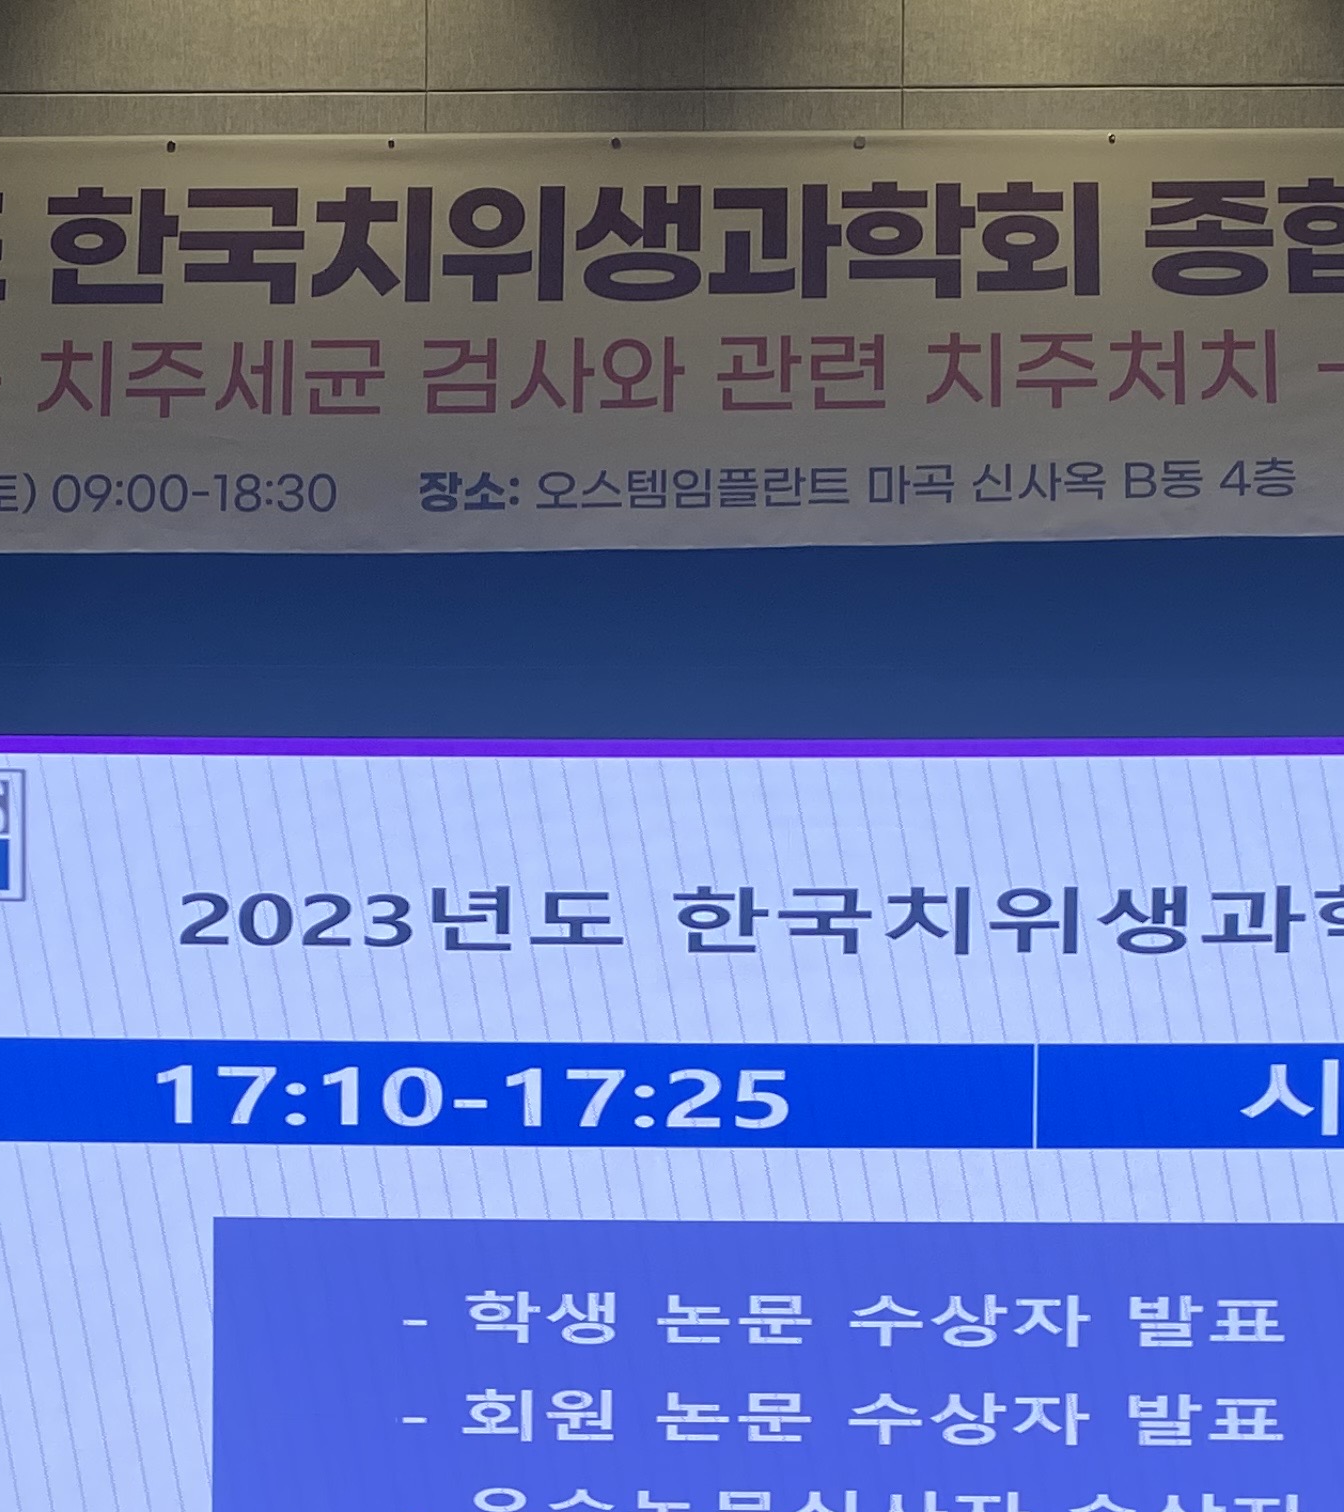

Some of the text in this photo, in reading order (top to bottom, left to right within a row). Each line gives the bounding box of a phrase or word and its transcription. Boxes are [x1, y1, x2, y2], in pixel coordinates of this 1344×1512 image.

[48, 182, 1100, 304] 한국치위생과학회
[37, 340, 385, 418] 치주세균
[423, 337, 685, 414] 검사와
[717, 334, 885, 410] 관련
[926, 329, 1277, 408] 치주처치
[53, 474, 336, 513] 09:00-18:30
[420, 457, 1295, 512] 장소: 오스템임플란트 마곡 신사옥 B동 4층
[181, 887, 623, 950] 2023년도
[158, 1065, 788, 1128] 17:10-17:25
[466, 1291, 615, 1344] 학생
[658, 1295, 812, 1344] 논문
[850, 1295, 1090, 1347] 수상자
[1130, 1296, 1284, 1346] 발표
[463, 1389, 613, 1441] 회원
[657, 1393, 811, 1441] 논문
[849, 1393, 1089, 1445] 수상자
[1129, 1394, 1283, 1445] 발표
